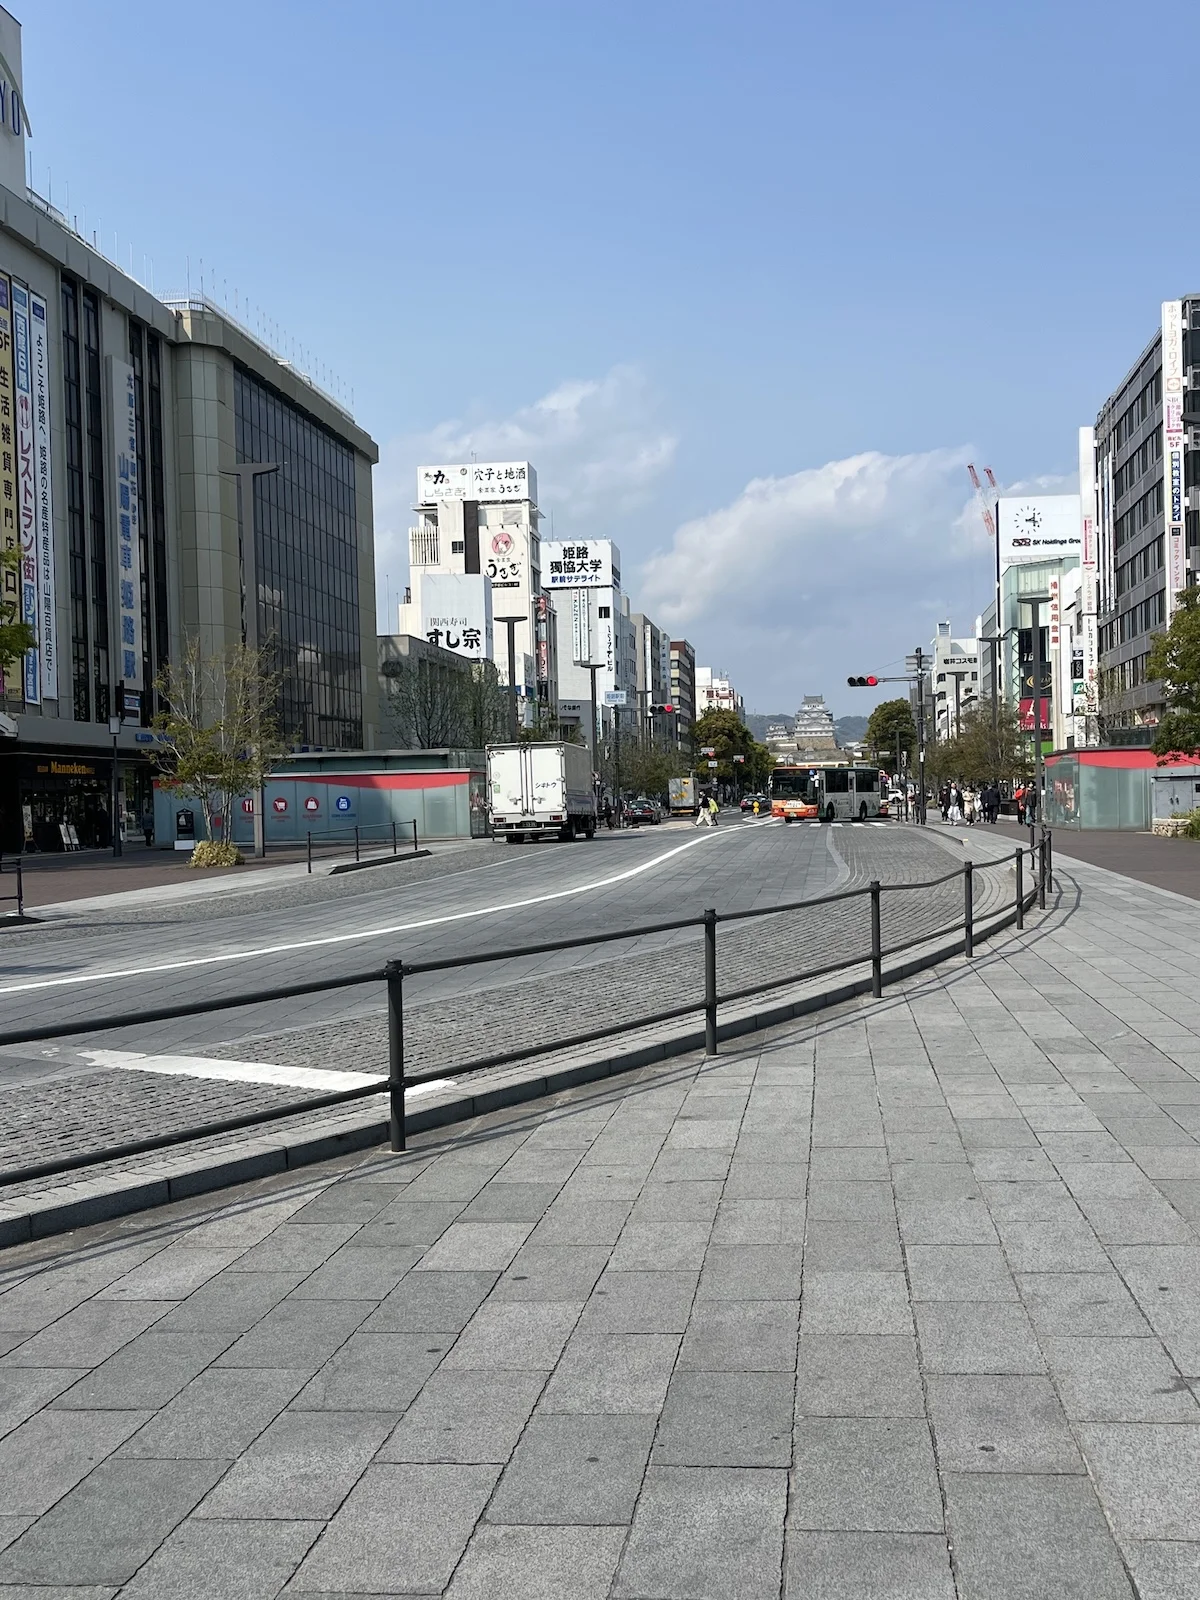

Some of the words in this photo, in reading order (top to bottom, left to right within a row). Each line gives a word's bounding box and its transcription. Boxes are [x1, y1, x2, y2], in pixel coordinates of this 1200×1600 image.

[474, 467, 526, 481] 穴子と地酒
[20, 430, 36, 583] レストラン街
[562, 546, 589, 560] 姫路
[550, 559, 602, 573] 獨協大学
[551, 575, 601, 583] 駅前サテライト
[430, 616, 468, 627] 関西寿司
[426, 628, 482, 650] すし宗
[51, 761, 86, 775] Manneken
